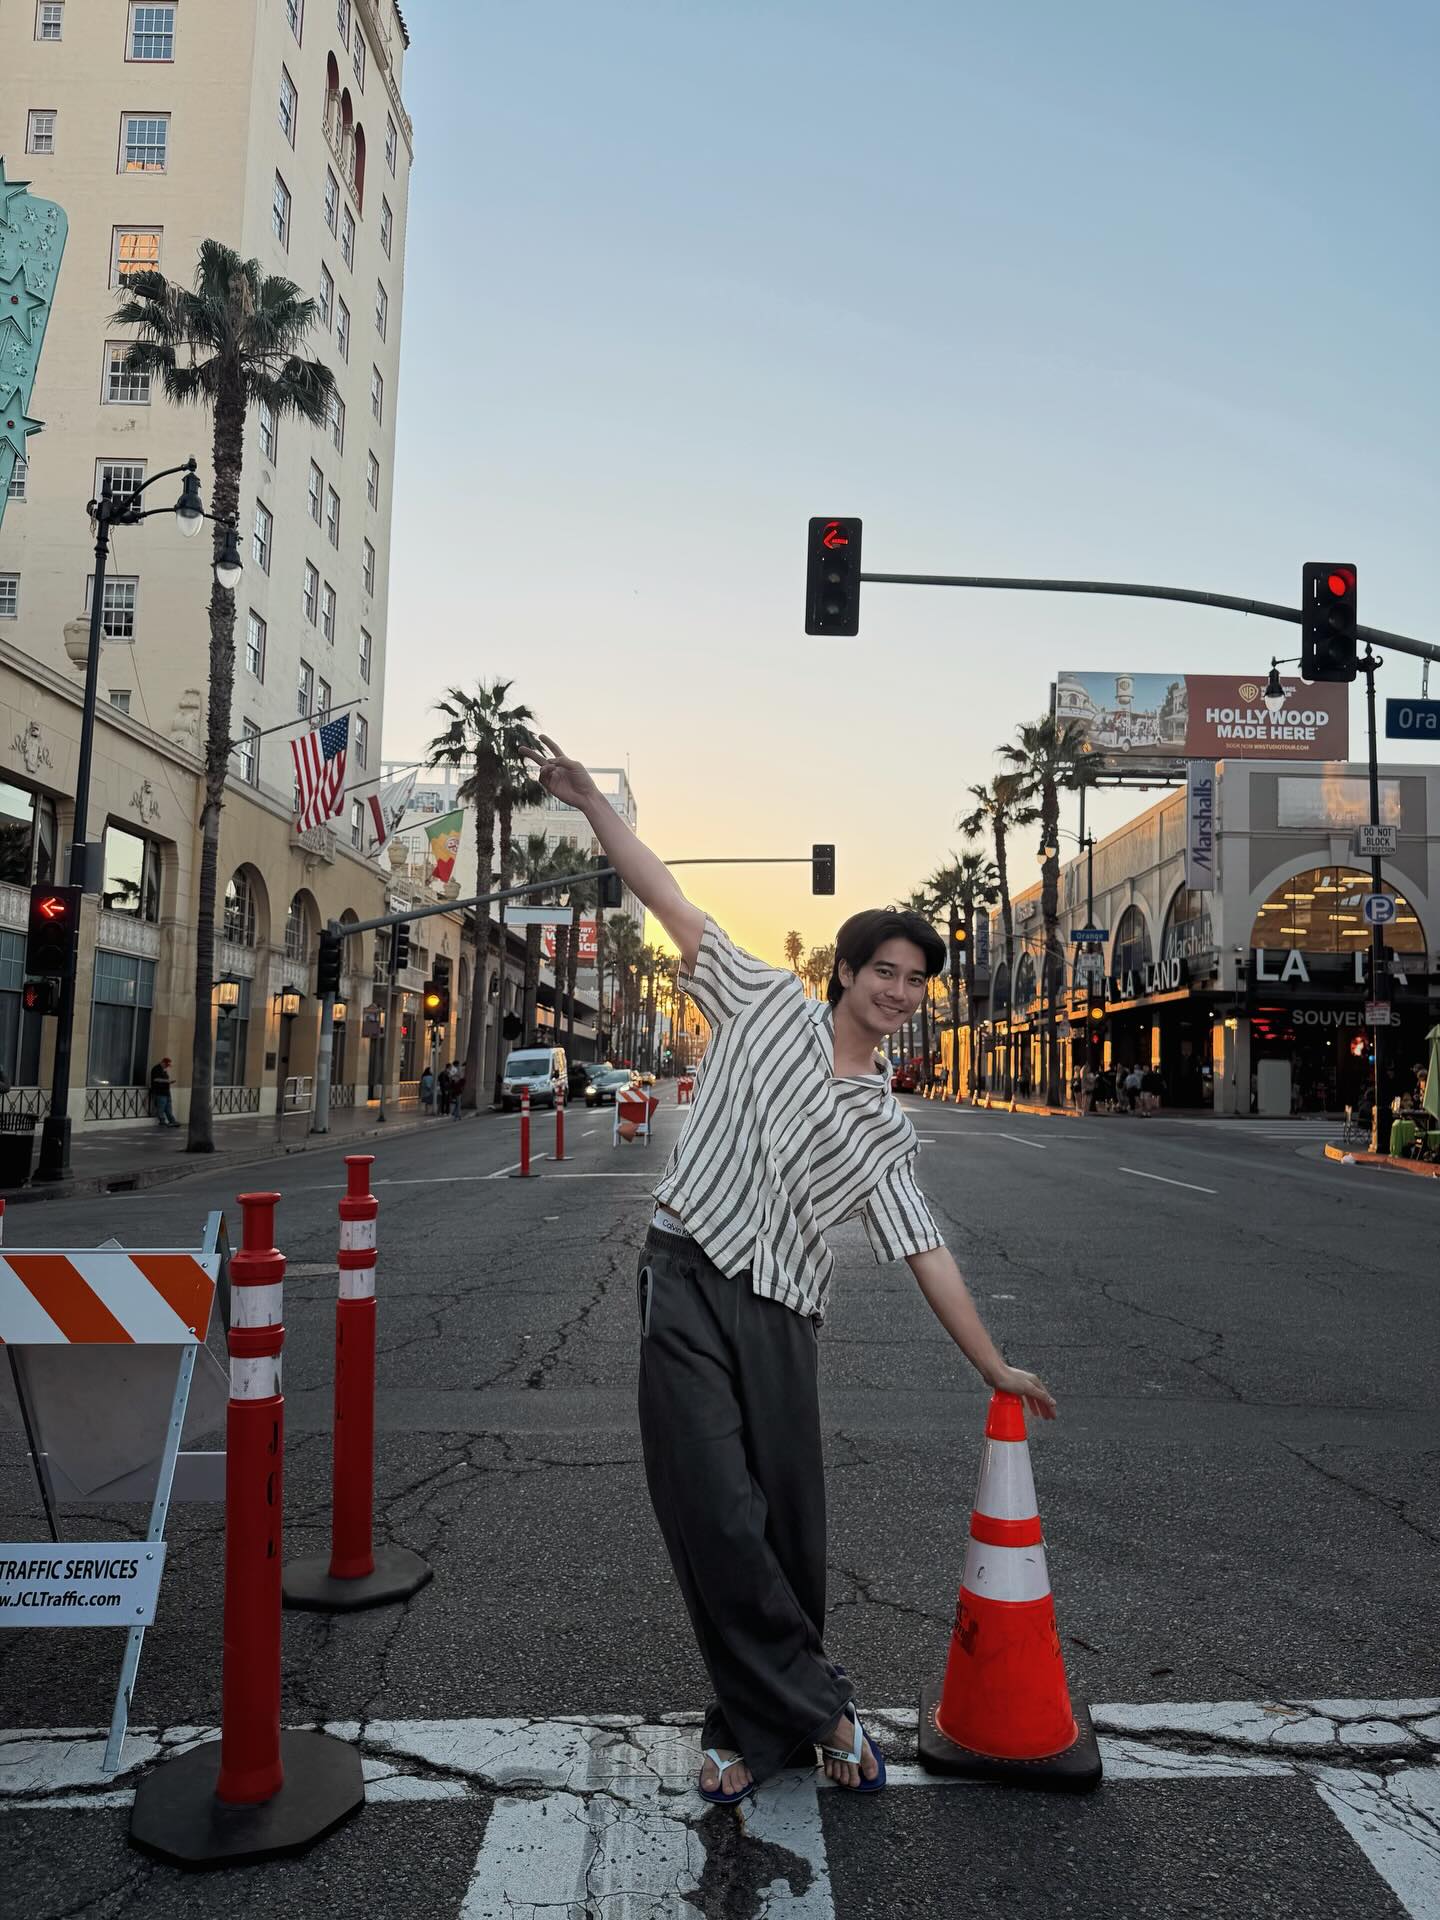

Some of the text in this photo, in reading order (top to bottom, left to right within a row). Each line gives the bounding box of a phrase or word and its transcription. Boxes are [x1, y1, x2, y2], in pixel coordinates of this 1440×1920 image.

[1206, 708, 1329, 726] HOLLYWOOD
[1399, 707, 1437, 729] Ora
[1217, 725, 1316, 741] MADE HERE
[1191, 778, 1212, 872] Marshalls
[1364, 827, 1392, 837] DO NOT
[1366, 837, 1390, 846] BLOCK
[1076, 932, 1104, 941] Orange
[1256, 948, 1310, 982] LA
[1145, 958, 1180, 993] LAND
[1292, 1009, 1401, 1027] SOUVENS
[662, 1218, 681, 1234] Calvin
[0, 1559, 139, 1580] TRAFFIC SERVICES
